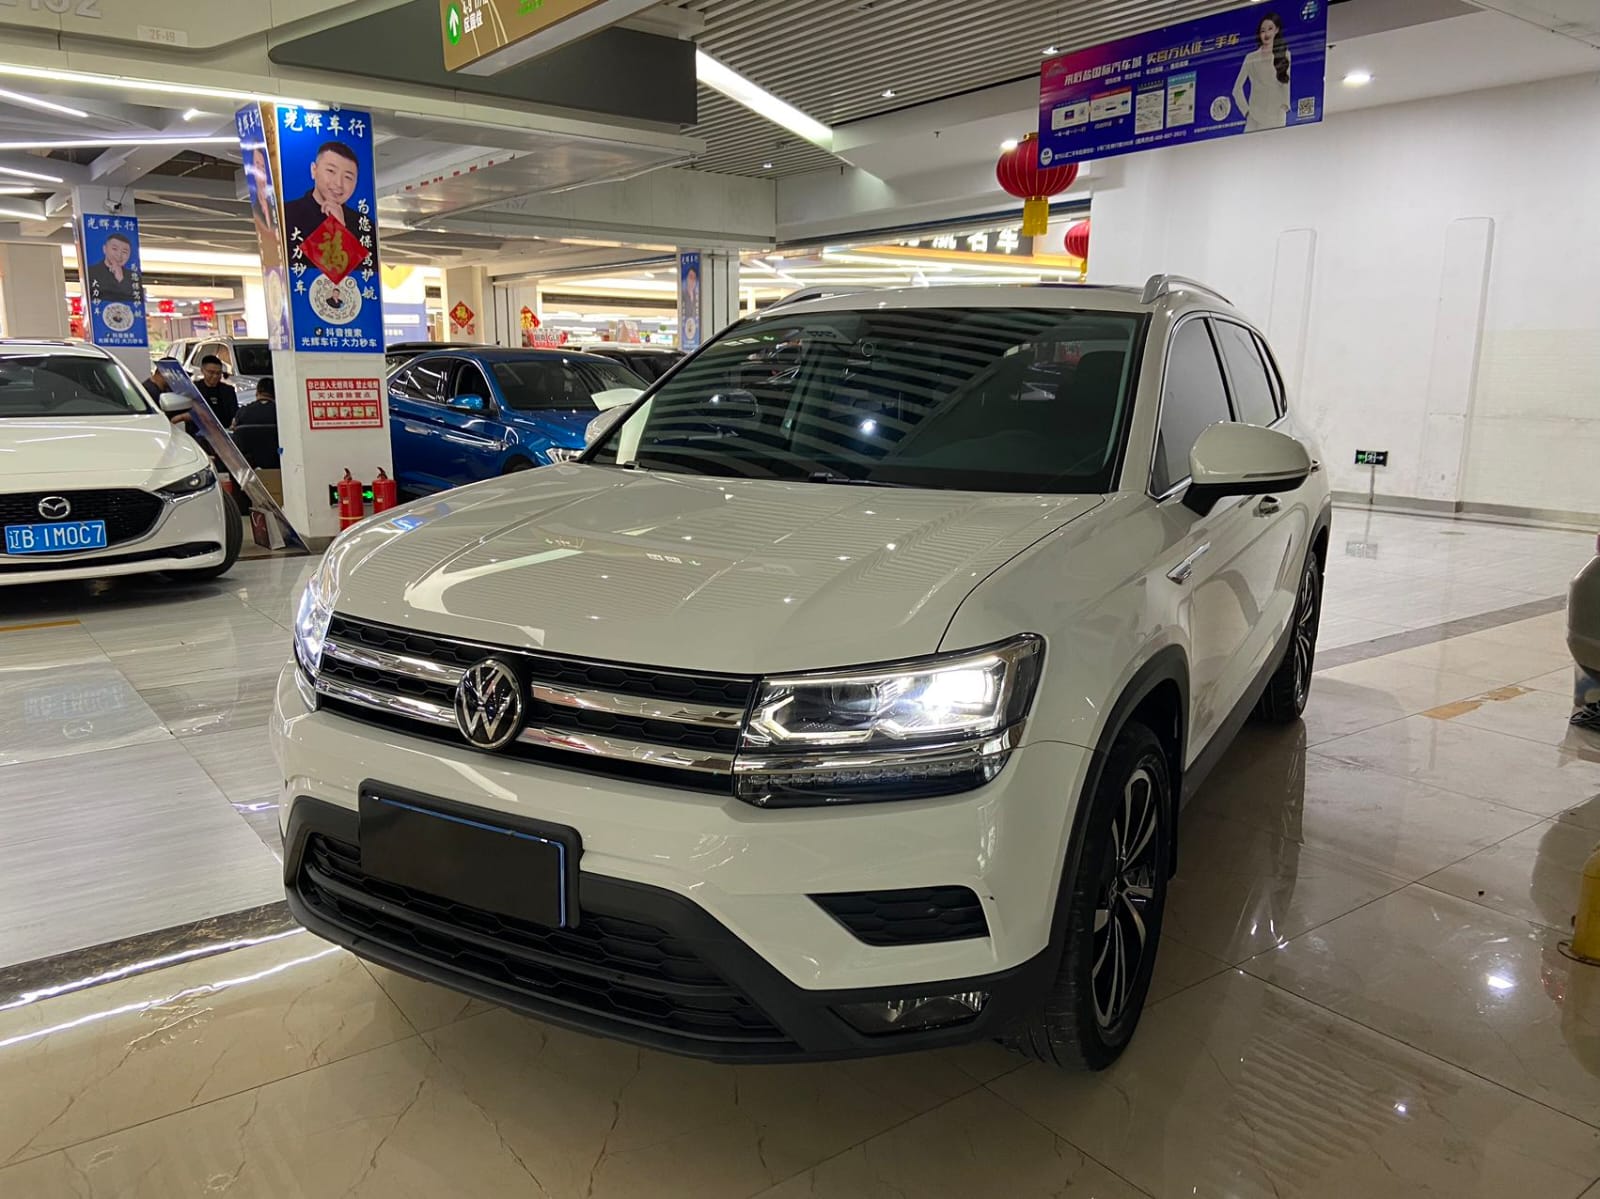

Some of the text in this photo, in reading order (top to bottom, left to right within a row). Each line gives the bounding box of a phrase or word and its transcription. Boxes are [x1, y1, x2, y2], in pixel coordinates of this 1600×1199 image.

[283, 108, 366, 138] 光辉车行
[88, 217, 136, 232] 光辉车行
[290, 226, 307, 296] 大力秒车
[325, 327, 363, 338] 抖音搜索
[301, 337, 377, 347] 光辉车行 大力秒车
